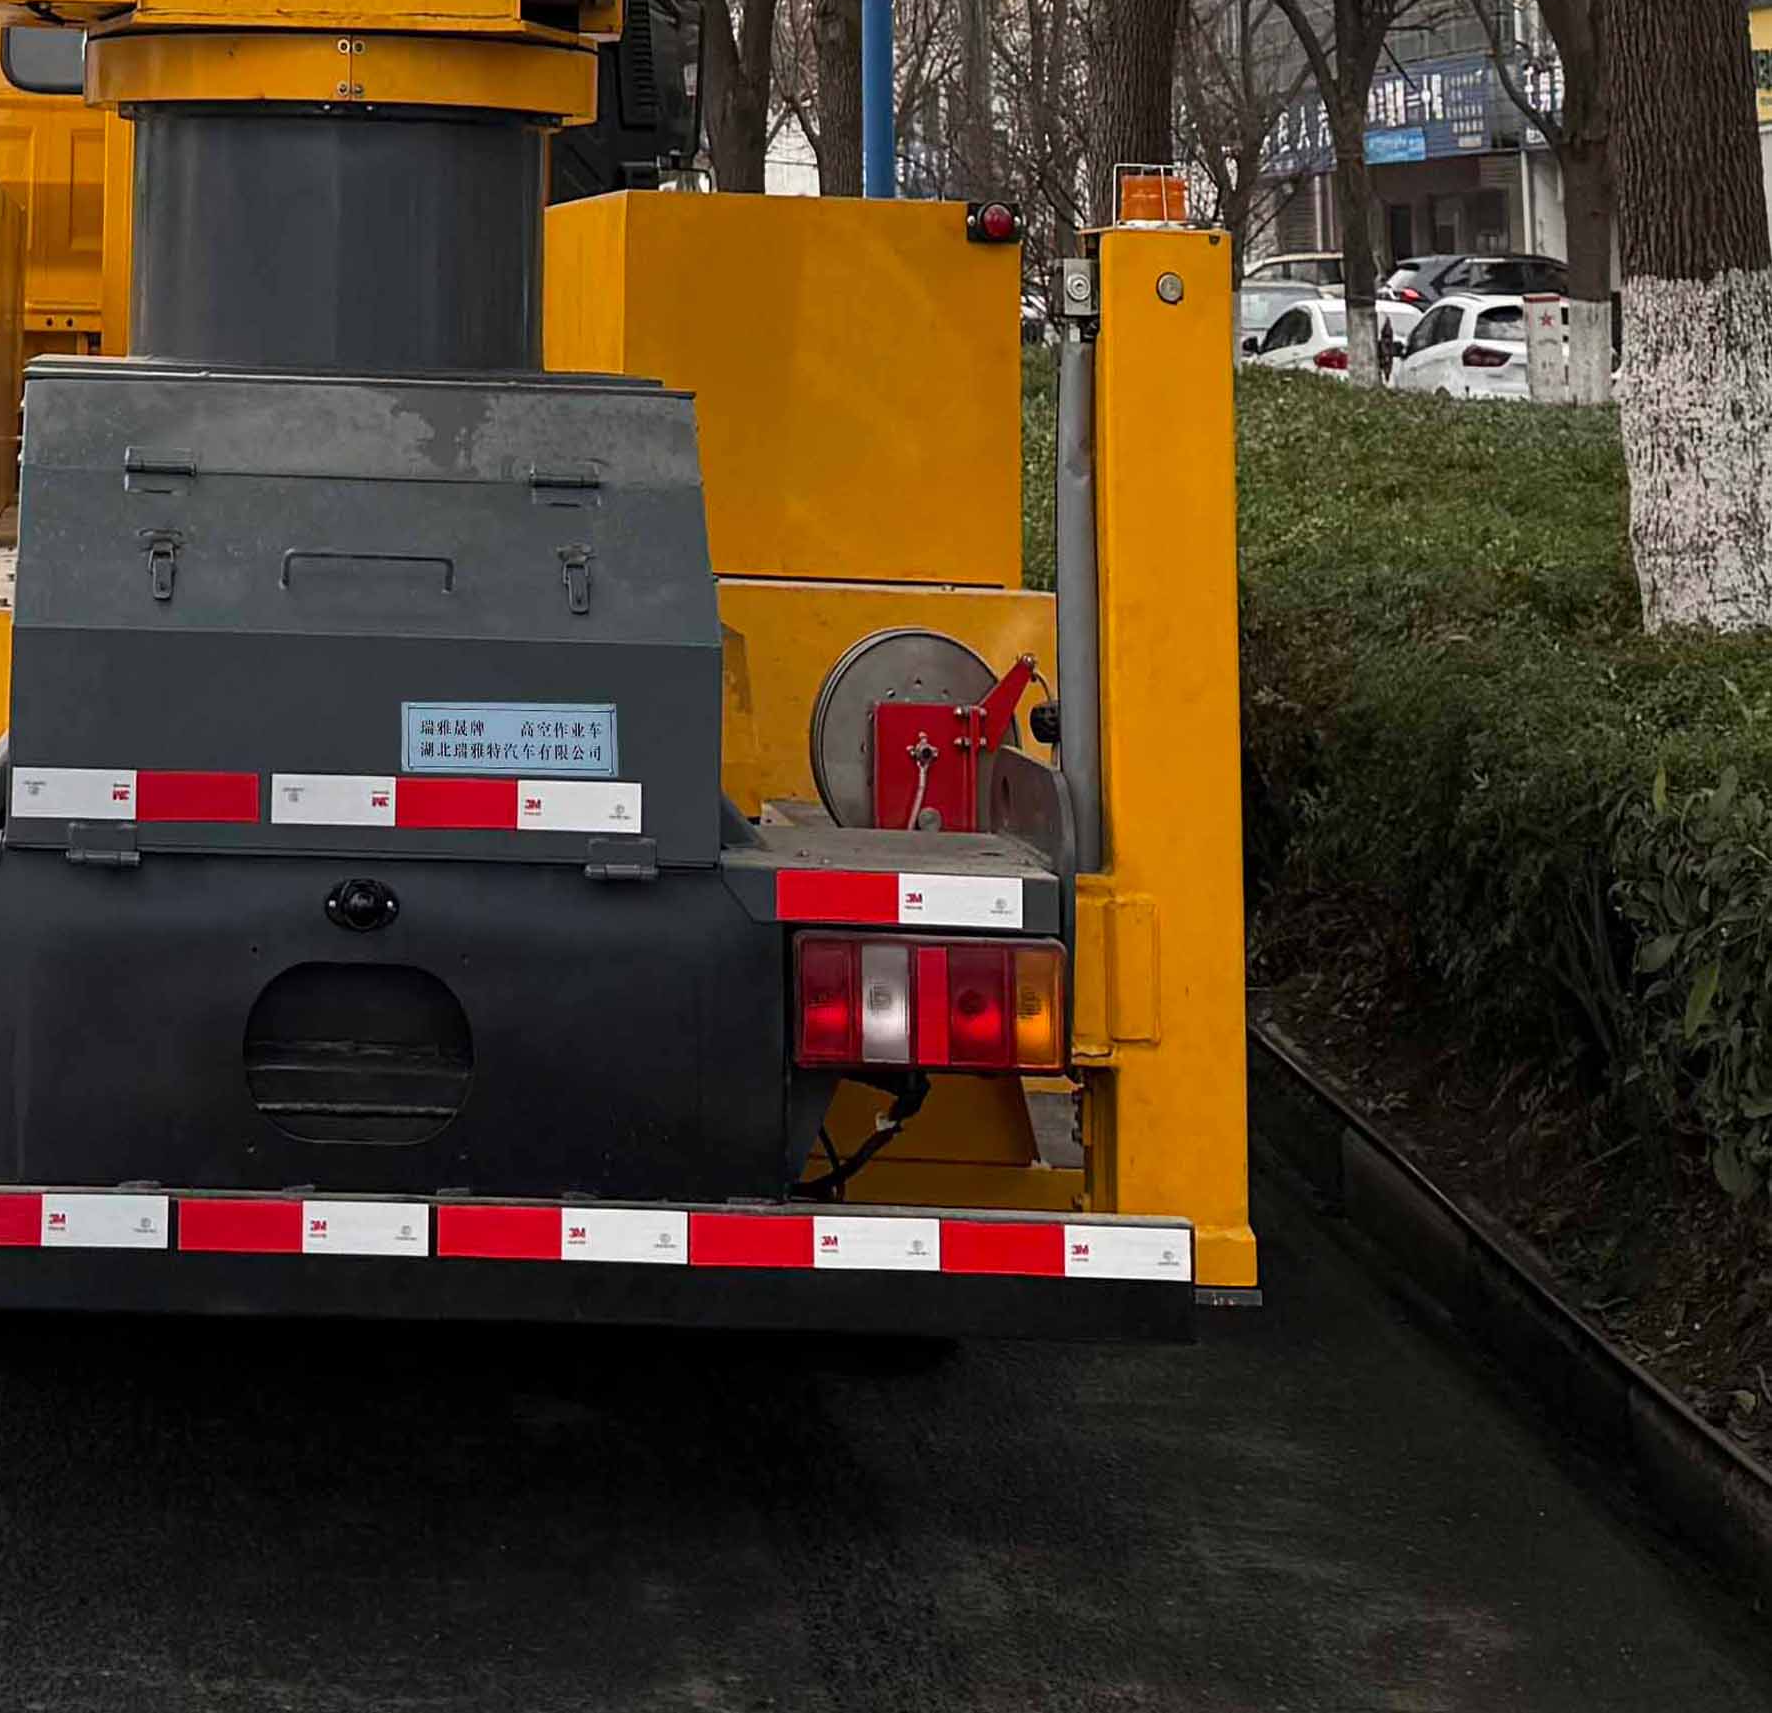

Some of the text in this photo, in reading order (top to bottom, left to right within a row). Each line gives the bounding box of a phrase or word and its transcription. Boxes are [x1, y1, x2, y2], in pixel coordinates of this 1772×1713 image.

[520, 721, 602, 740] 高空作业车
[420, 741, 602, 762] 湖北瑞雅特汽车有限公司
